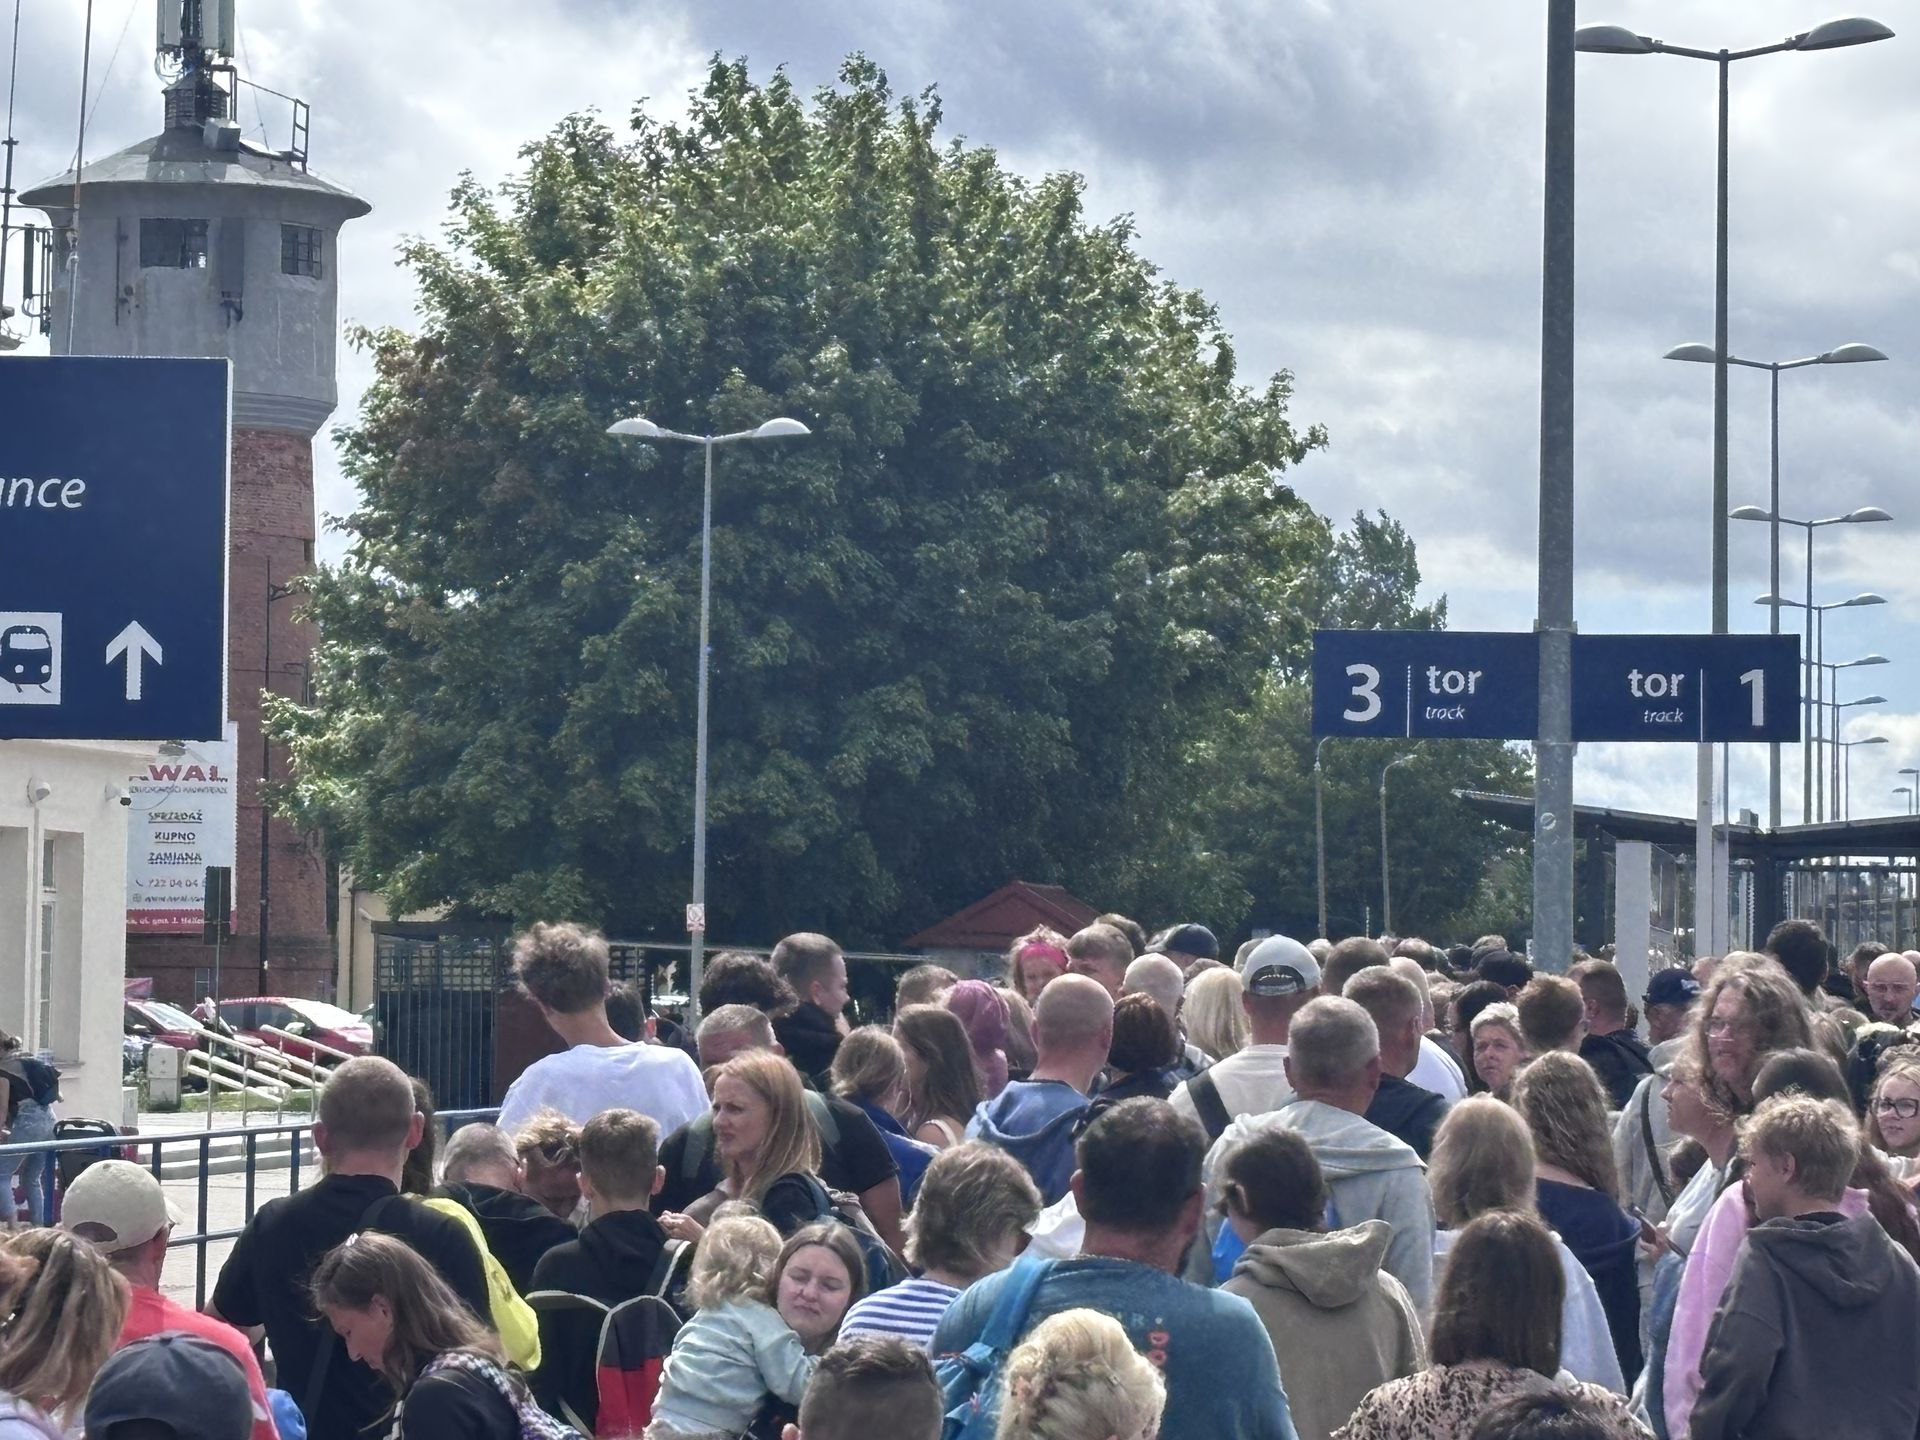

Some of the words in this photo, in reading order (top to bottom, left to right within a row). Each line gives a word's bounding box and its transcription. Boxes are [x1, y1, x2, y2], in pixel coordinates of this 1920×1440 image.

[0, 477, 86, 509] nce
[1343, 663, 1382, 722] 3
[1426, 665, 1482, 695] tor
[1628, 668, 1684, 698] tor
[1425, 704, 1466, 720] track
[1739, 668, 1764, 727] 1
[1643, 707, 1684, 723] track
[154, 832, 196, 841] KUPNO
[147, 852, 202, 861] ZAMIANA
